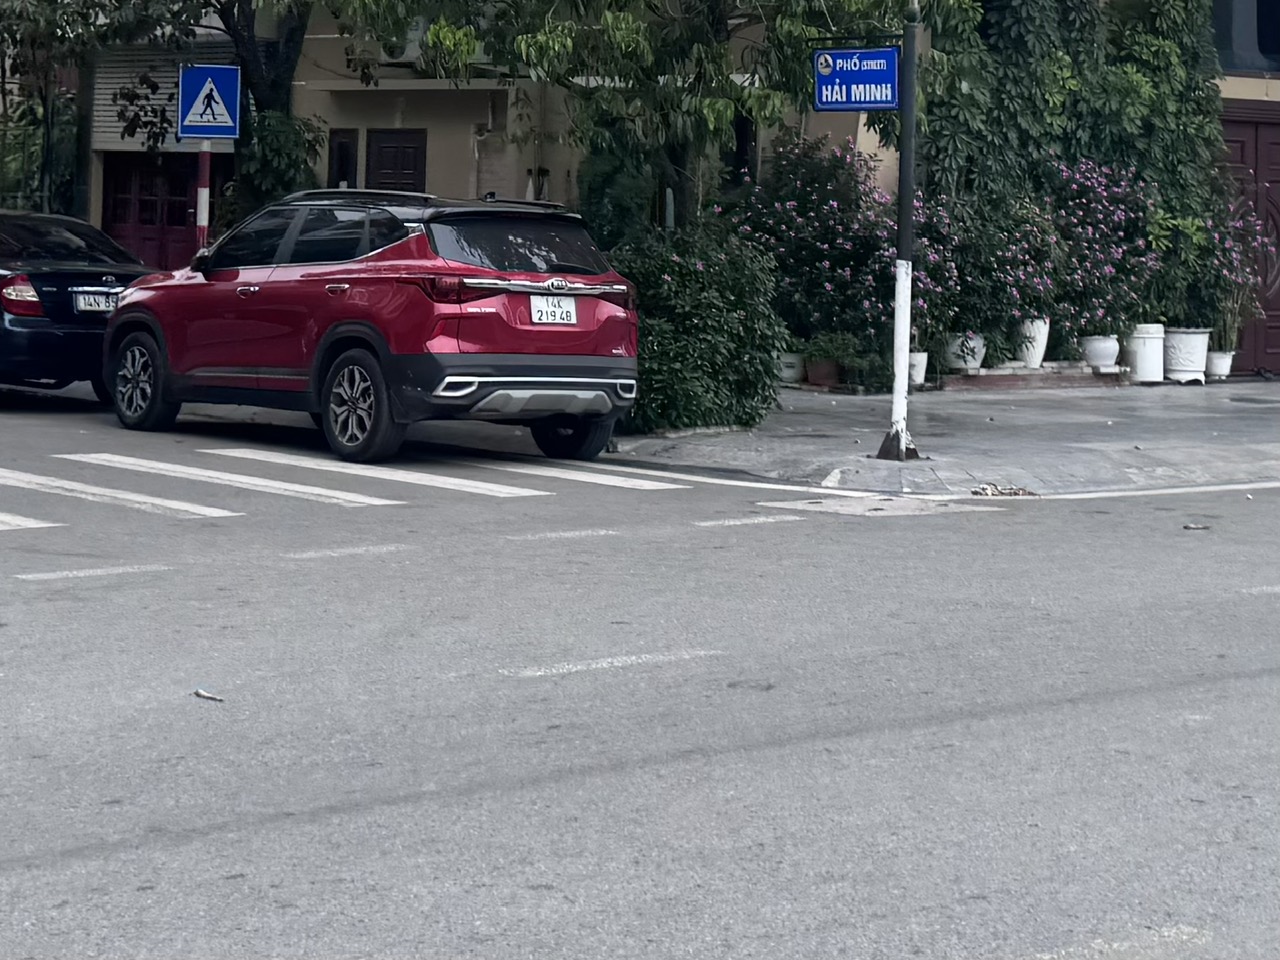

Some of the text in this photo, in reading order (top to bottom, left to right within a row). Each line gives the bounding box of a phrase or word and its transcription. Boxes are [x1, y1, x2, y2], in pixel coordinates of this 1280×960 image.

[836, 53, 860, 71] PHỐ
[822, 78, 892, 102] HẢI MINH
